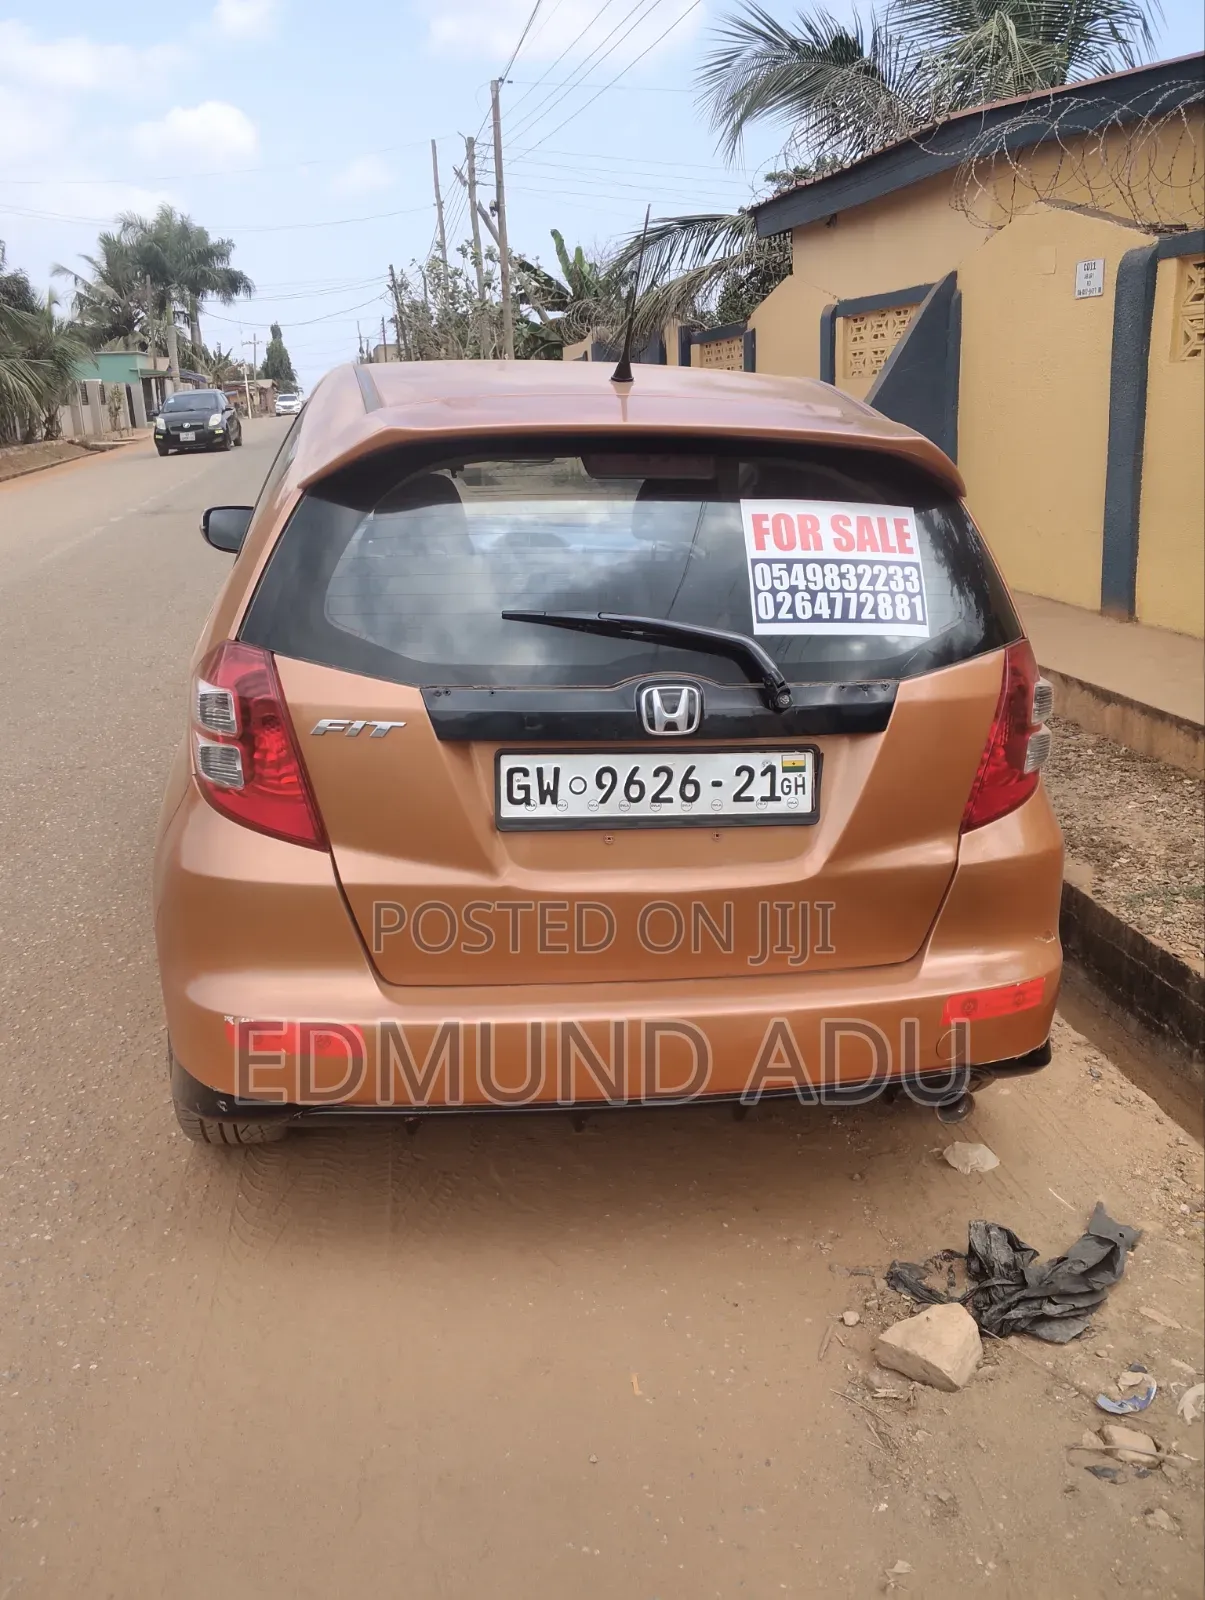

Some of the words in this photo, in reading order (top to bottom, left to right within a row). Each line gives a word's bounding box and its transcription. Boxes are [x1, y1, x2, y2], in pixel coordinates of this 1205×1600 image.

[751, 512, 824, 552] FOR
[830, 514, 914, 554] SALE
[754, 562, 921, 593] 0549832233
[757, 591, 924, 622] 0264772881
[310, 718, 407, 738] FIT
[506, 765, 561, 806] GW
[780, 776, 806, 796] GH
